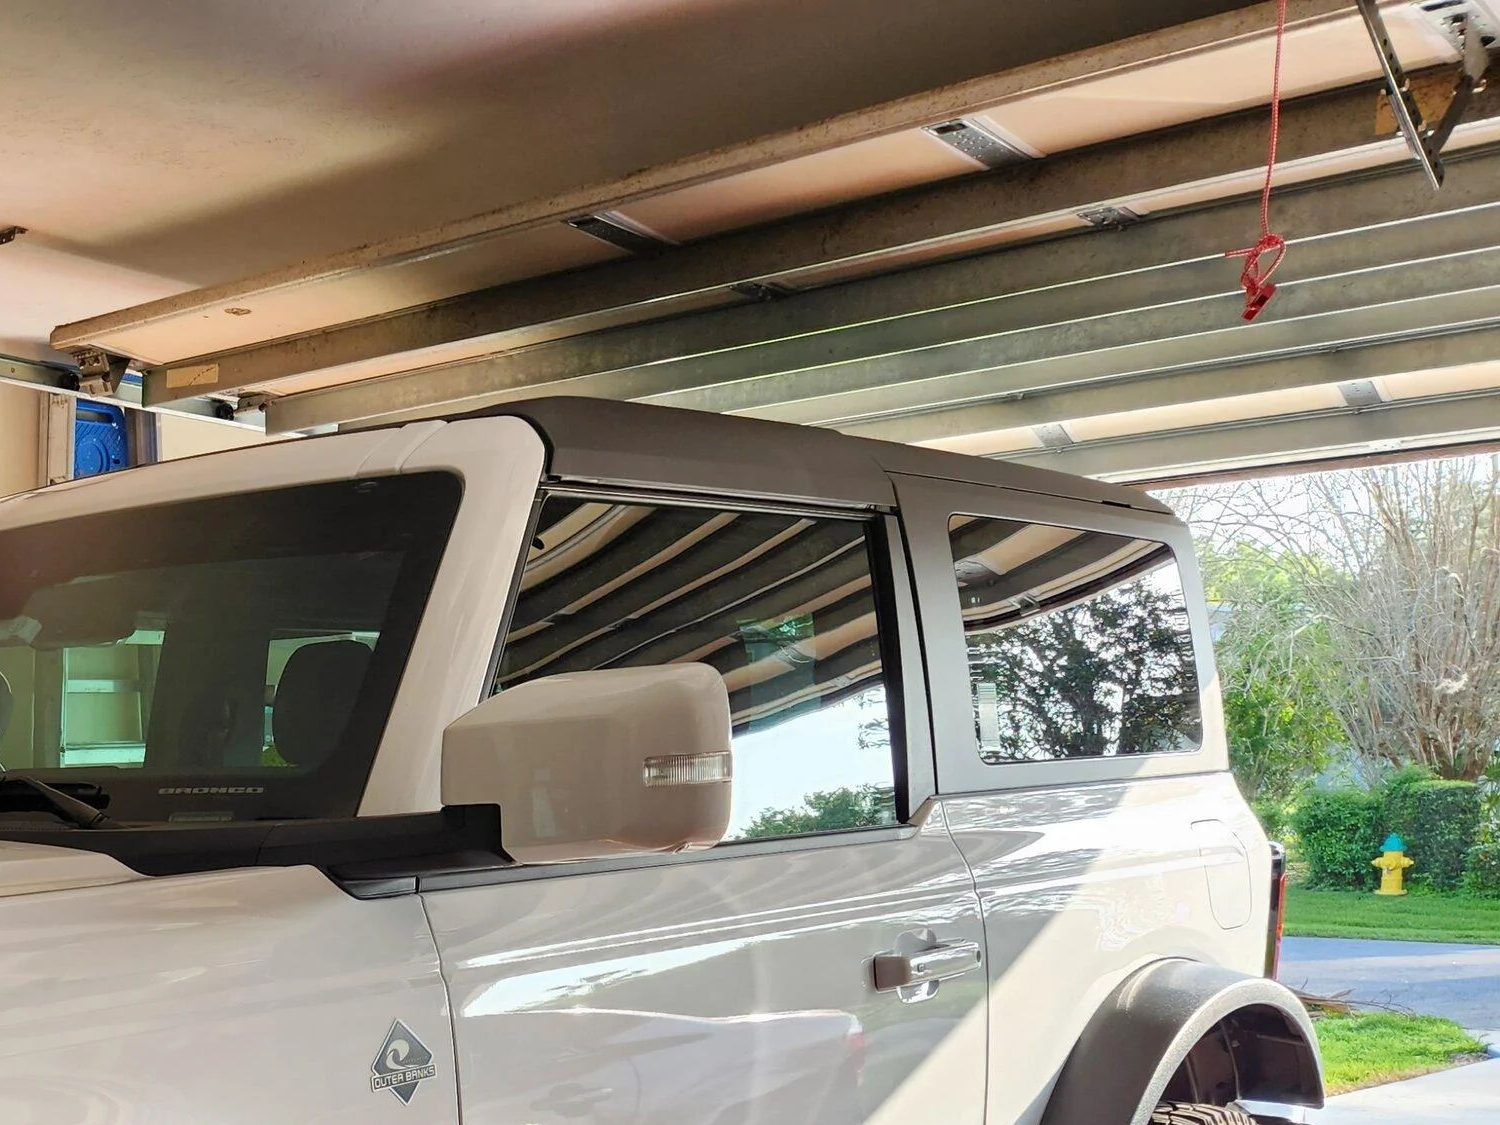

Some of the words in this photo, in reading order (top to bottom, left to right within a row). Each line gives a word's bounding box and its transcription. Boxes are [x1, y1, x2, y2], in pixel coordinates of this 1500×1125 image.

[158, 787, 264, 795] BRONCO
[374, 1073, 404, 1088] OUTER
[406, 1066, 435, 1080] BANKS
